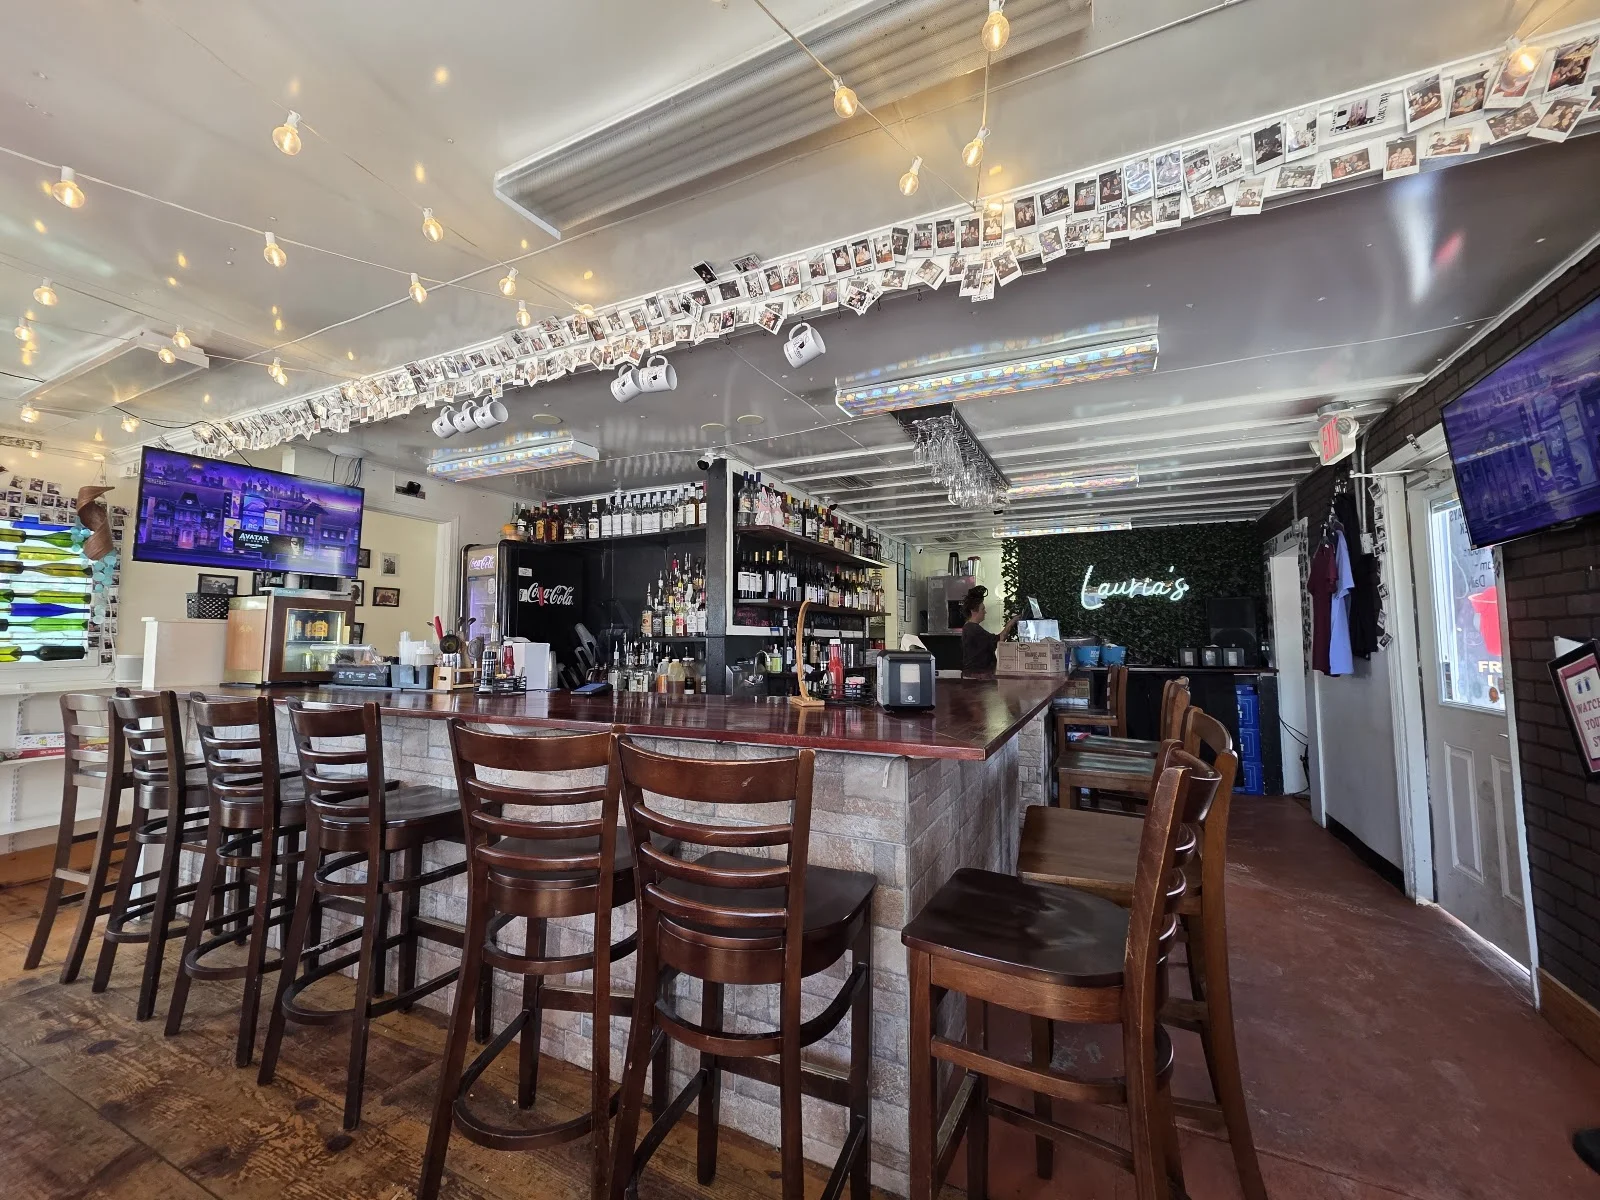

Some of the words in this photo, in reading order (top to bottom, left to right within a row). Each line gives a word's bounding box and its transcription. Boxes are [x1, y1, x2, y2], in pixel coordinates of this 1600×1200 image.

[1322, 416, 1339, 462] EXIT
[239, 532, 269, 541] AVATAR
[527, 582, 574, 606] Coa-Cola
[1081, 565, 1189, 610] Lauria's
